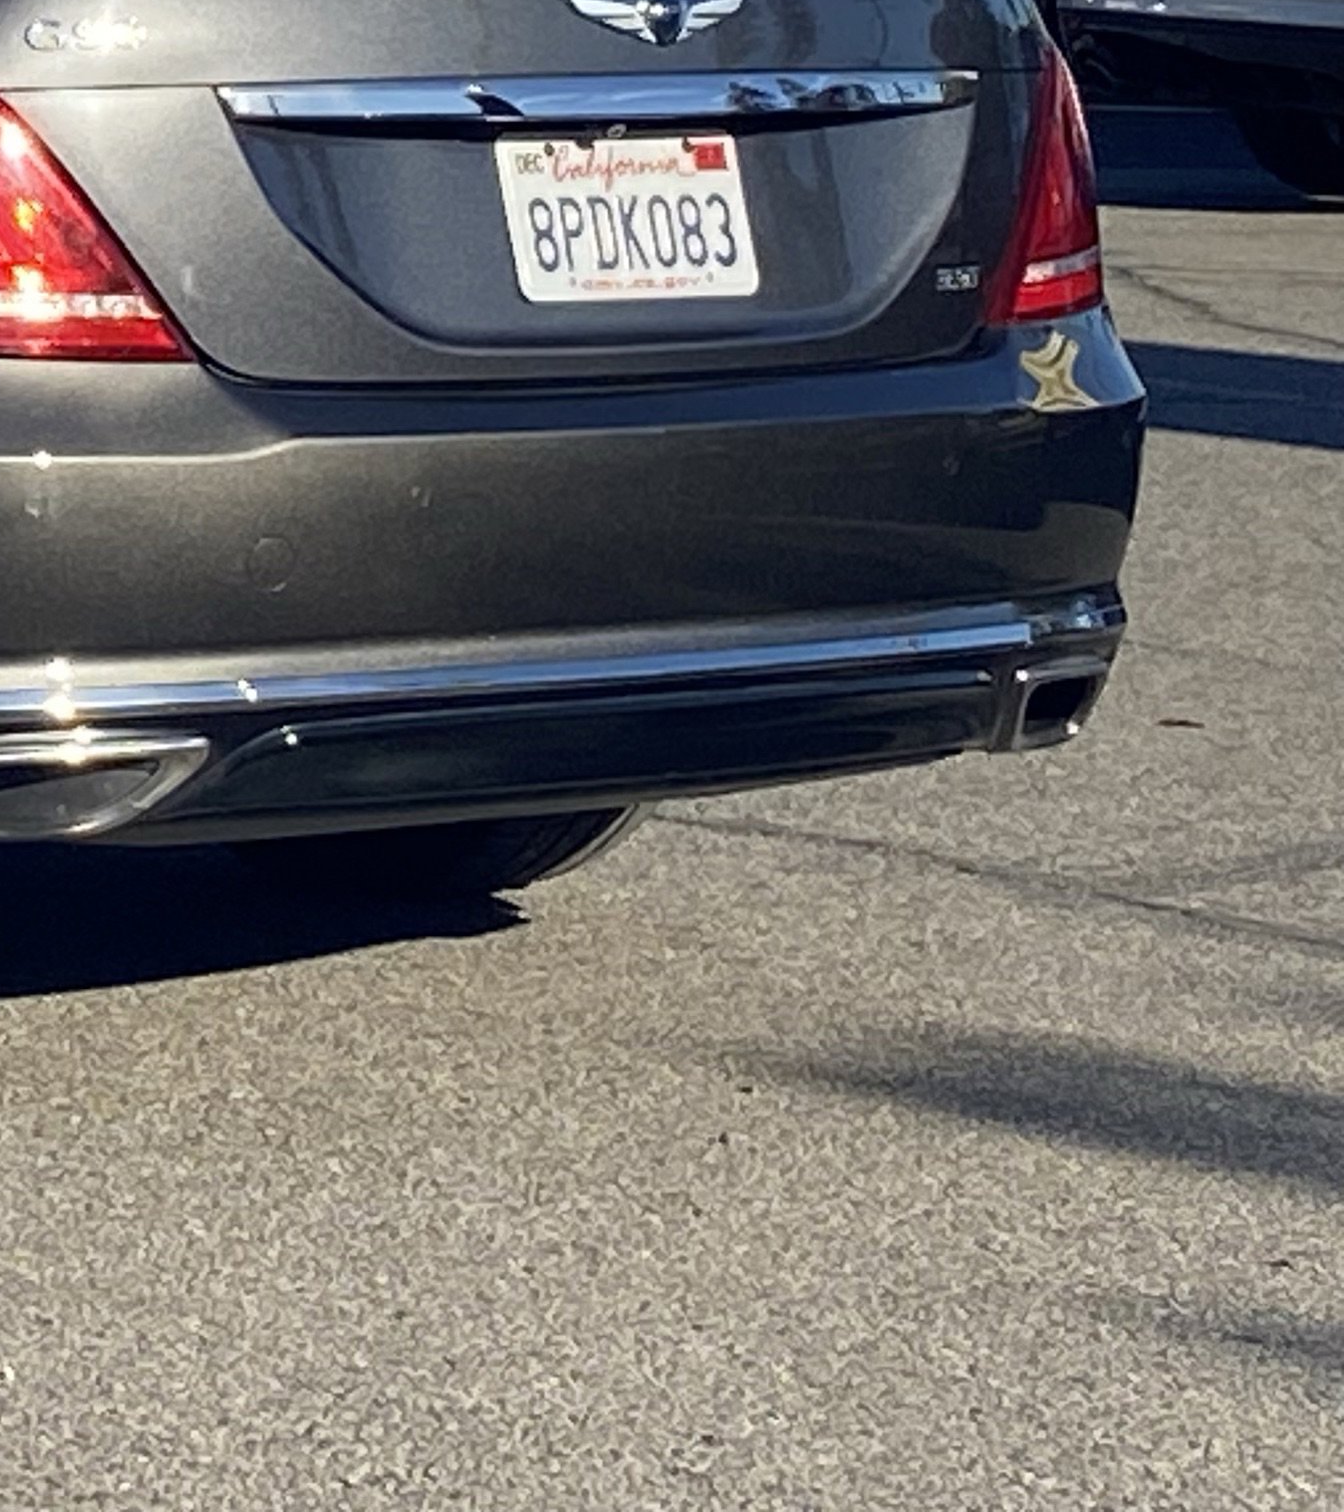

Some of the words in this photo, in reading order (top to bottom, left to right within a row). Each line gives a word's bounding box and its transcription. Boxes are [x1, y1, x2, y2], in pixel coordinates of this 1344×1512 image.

[515, 152, 545, 174] DEC
[552, 143, 696, 193] California
[527, 192, 738, 273] 8PDK083
